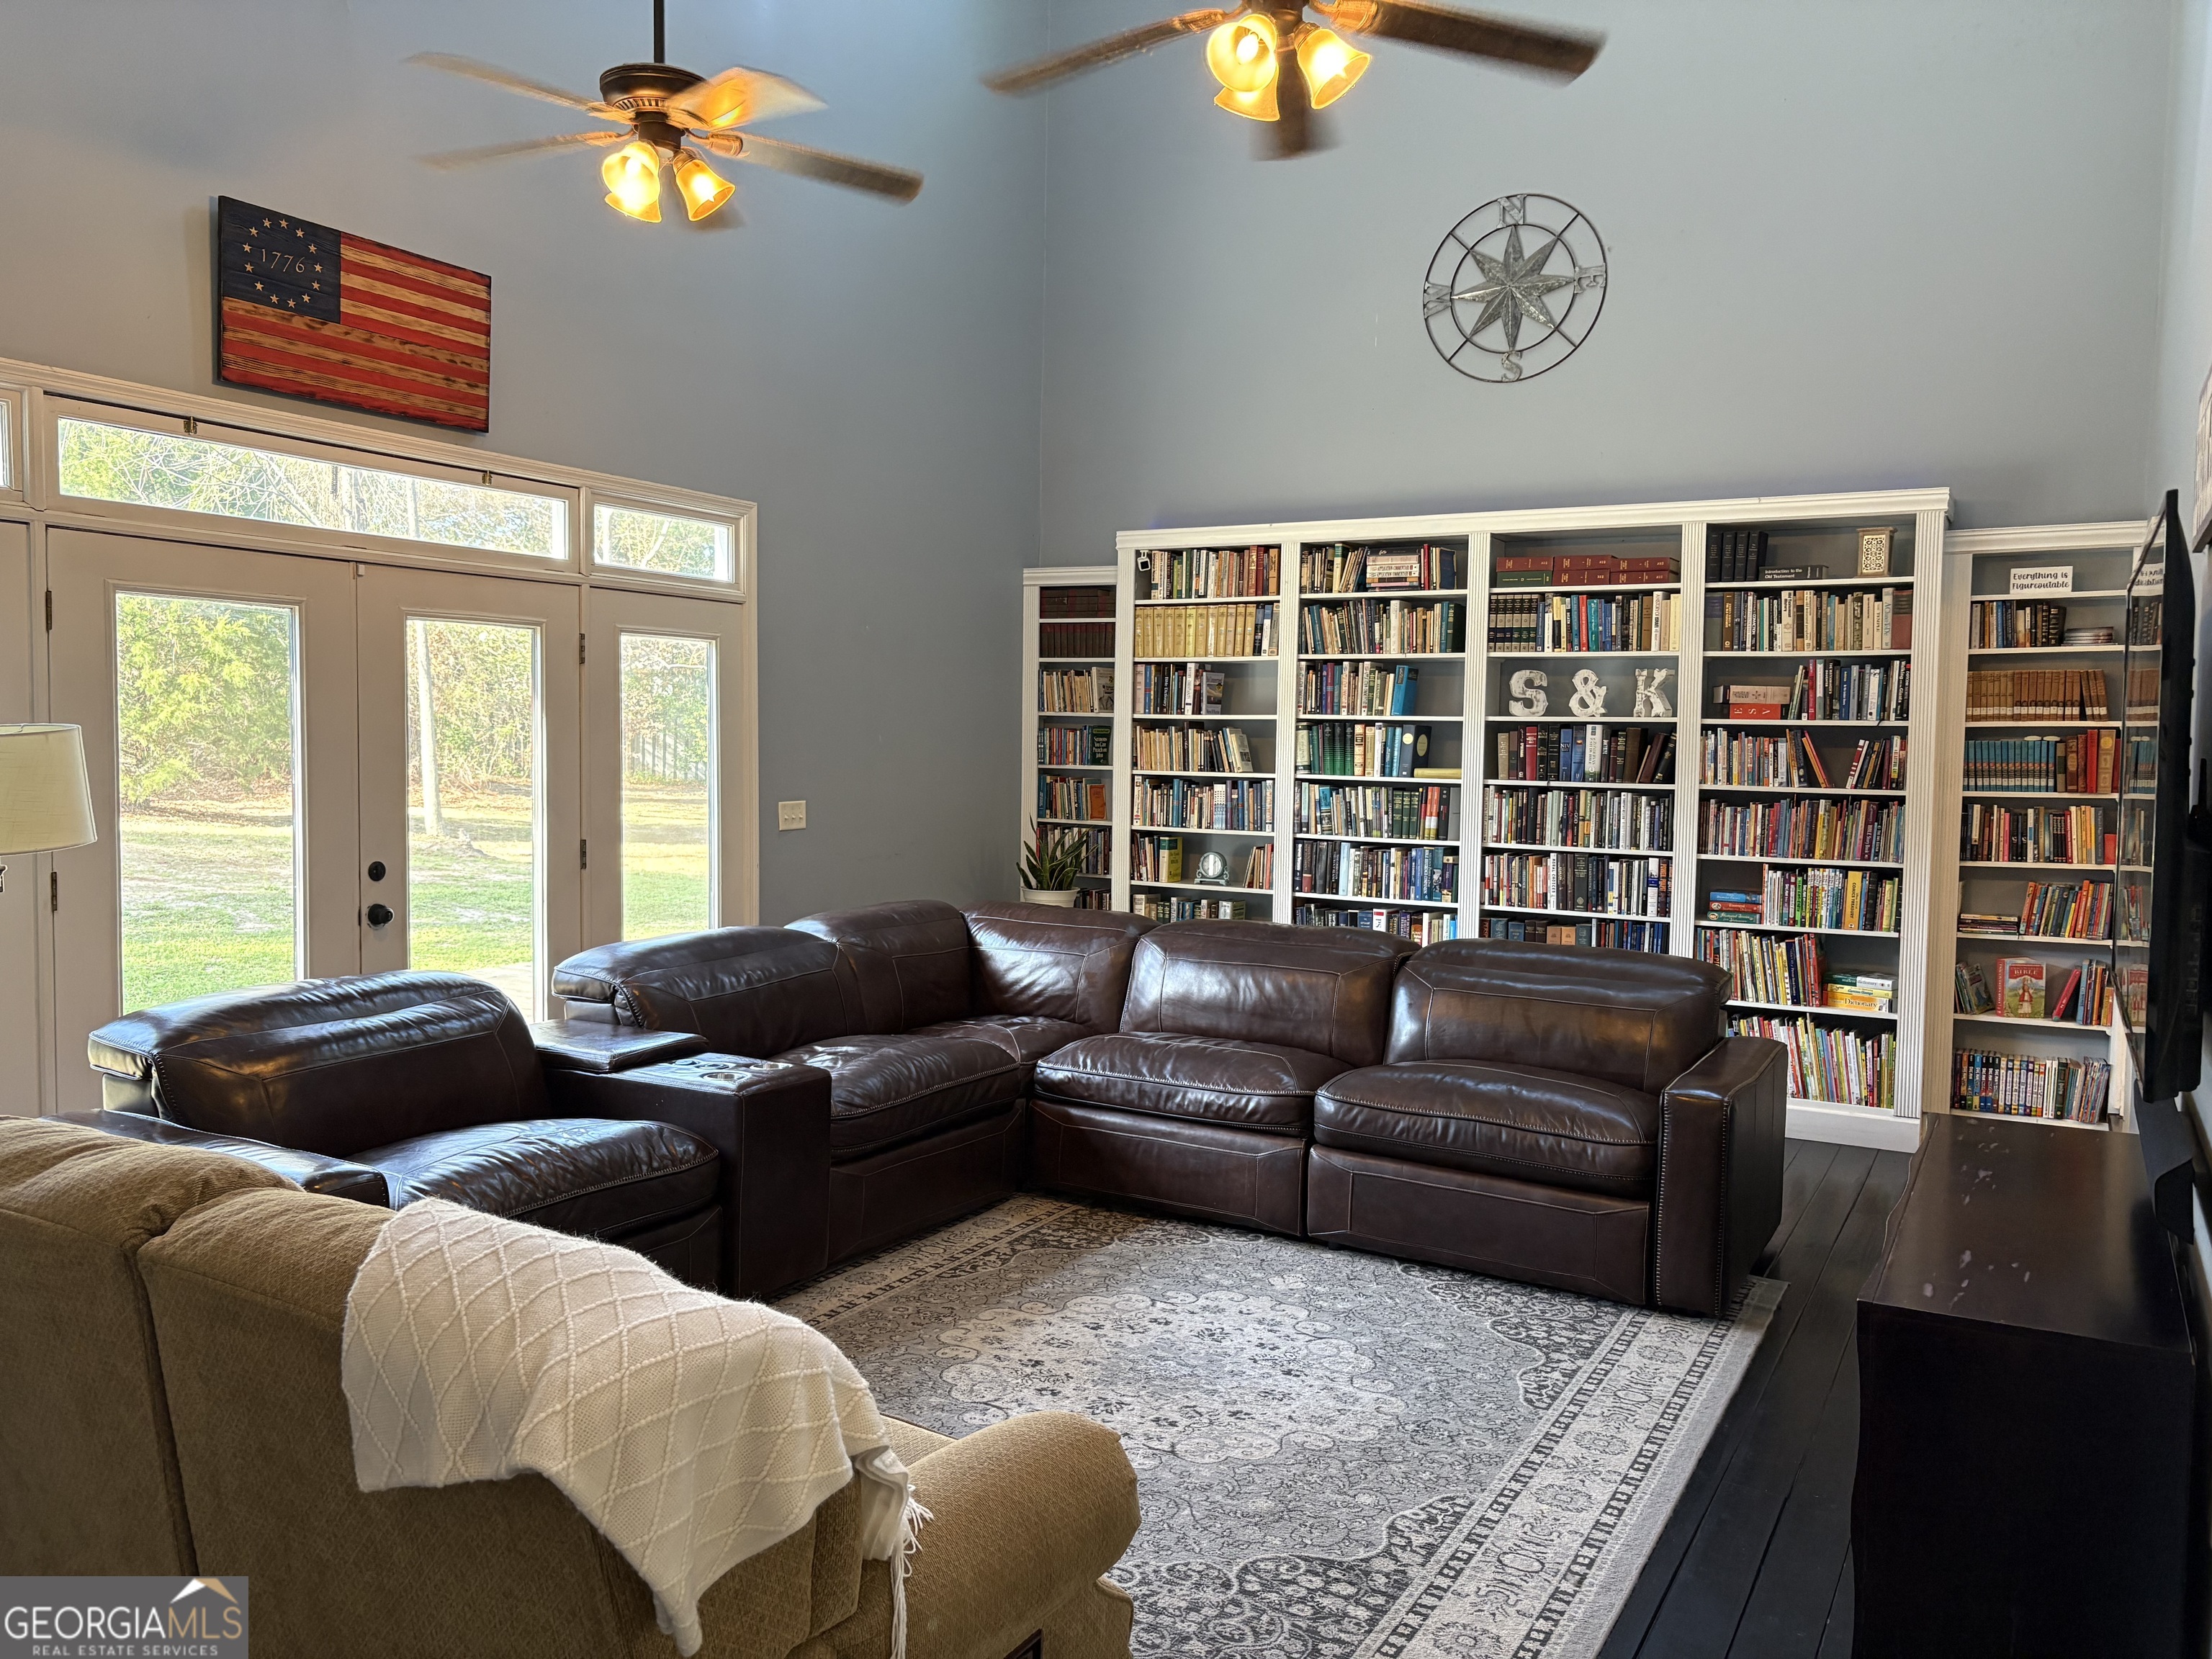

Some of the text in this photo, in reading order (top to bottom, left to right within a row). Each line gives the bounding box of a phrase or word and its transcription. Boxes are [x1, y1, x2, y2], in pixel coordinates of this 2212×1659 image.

[262, 248, 305, 273] 1776
[2013, 572, 2058, 580] Everything
[2012, 580, 2069, 590] Figureoutable
[1509, 668, 1673, 717] S & K
[1845, 998, 1878, 1008] Dictionary
